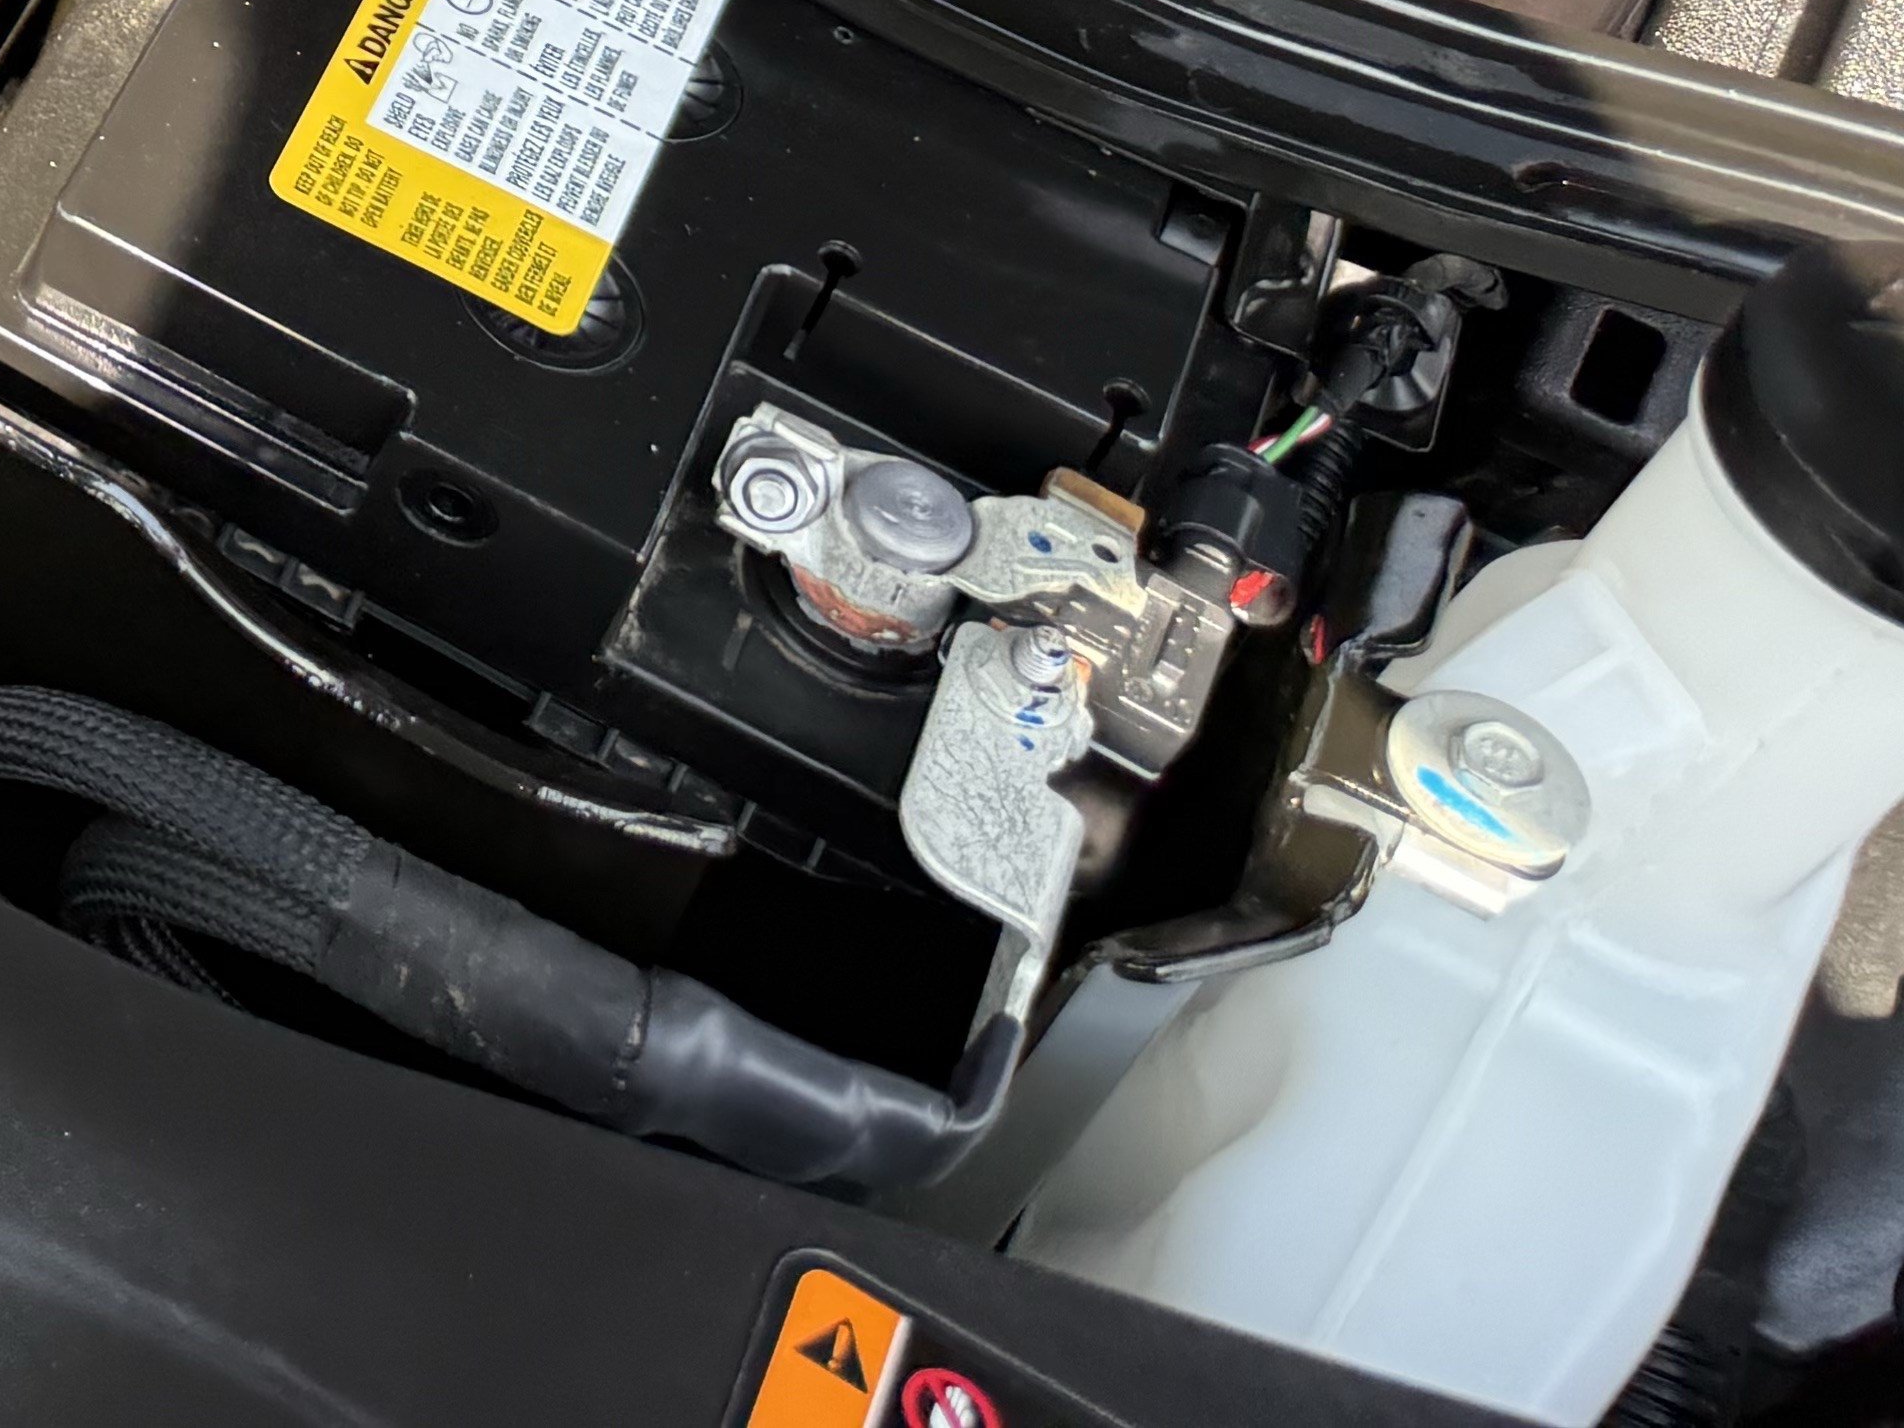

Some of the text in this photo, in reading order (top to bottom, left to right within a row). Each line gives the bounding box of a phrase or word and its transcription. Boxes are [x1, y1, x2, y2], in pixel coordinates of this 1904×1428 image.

[456, 22, 479, 40] NO
[614, 3, 636, 27] PEUT
[504, 12, 542, 63] OR SMOKING
[528, 42, 565, 78] ÉVITER
[559, 70, 581, 90] LES
[583, 81, 605, 101] LES
[606, 70, 638, 112] DE FUMER
[383, 91, 415, 129] SHIELD
[407, 112, 436, 141] EYES
[430, 105, 466, 151] EXPLOSIVE
[454, 89, 502, 162] GASES CAN CAUSE
[478, 86, 533, 174] BLINDNESS OR INJURY
[505, 95, 565, 190] PROTÉGEZ LES YEUX
[293, 114, 347, 195] KEEP OUT OF REACH
[314, 190, 333, 206] OF
[343, 134, 364, 152] DO
[362, 148, 385, 170] NOT
[531, 123, 582, 202] LES GAZ EXPLOSIFS
[354, 166, 376, 183] DO
[556, 173, 586, 214] PEUVENT
[572, 139, 602, 178] BLESSER
[579, 153, 626, 226] RENDRE AVEUGLE
[337, 195, 360, 218] NOT
[359, 202, 384, 228] OPEN
[467, 206, 489, 225] PAS
[422, 244, 443, 260] LA
[441, 201, 464, 221] DES
[536, 240, 557, 257] ET
[490, 257, 519, 293] GARDER
[536, 299, 558, 317] DE
